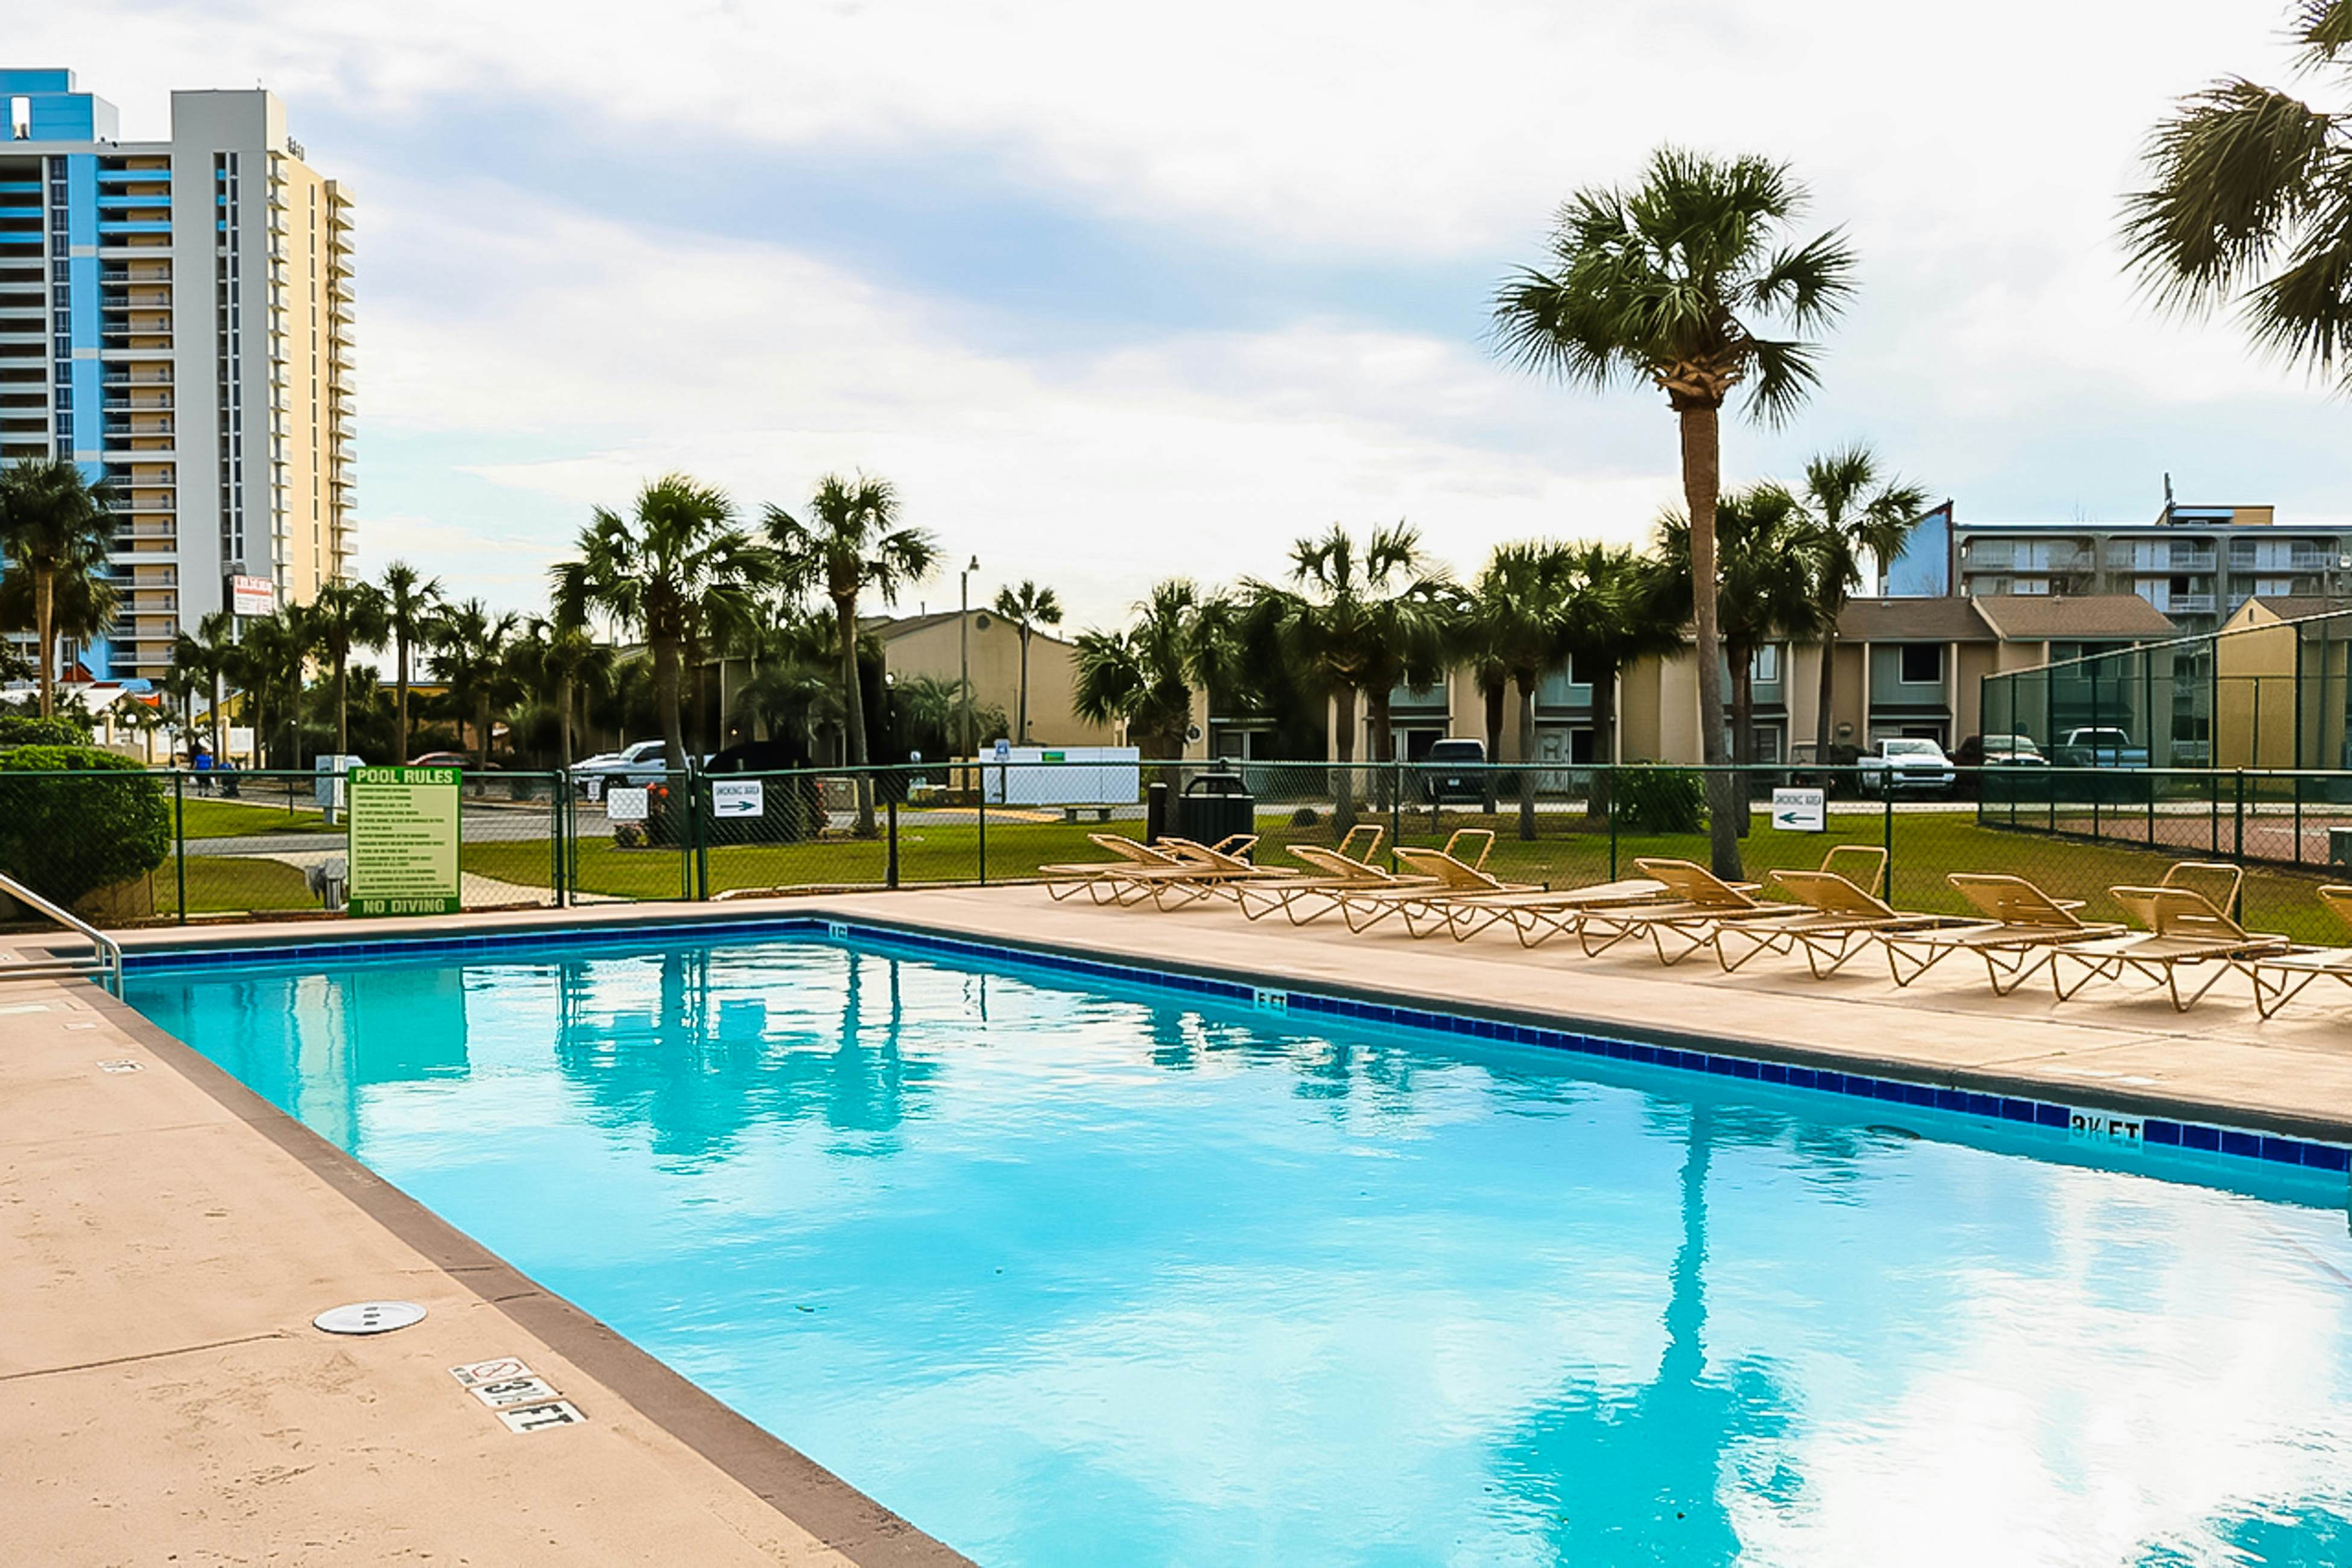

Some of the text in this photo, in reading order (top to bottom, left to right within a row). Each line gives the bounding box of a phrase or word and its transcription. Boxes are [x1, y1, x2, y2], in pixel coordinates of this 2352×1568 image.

[356, 769, 454, 784] POOL RULES
[363, 898, 445, 914] NO DIVING
[2109, 1119, 2139, 1138] FT
[509, 1404, 574, 1430] FT
